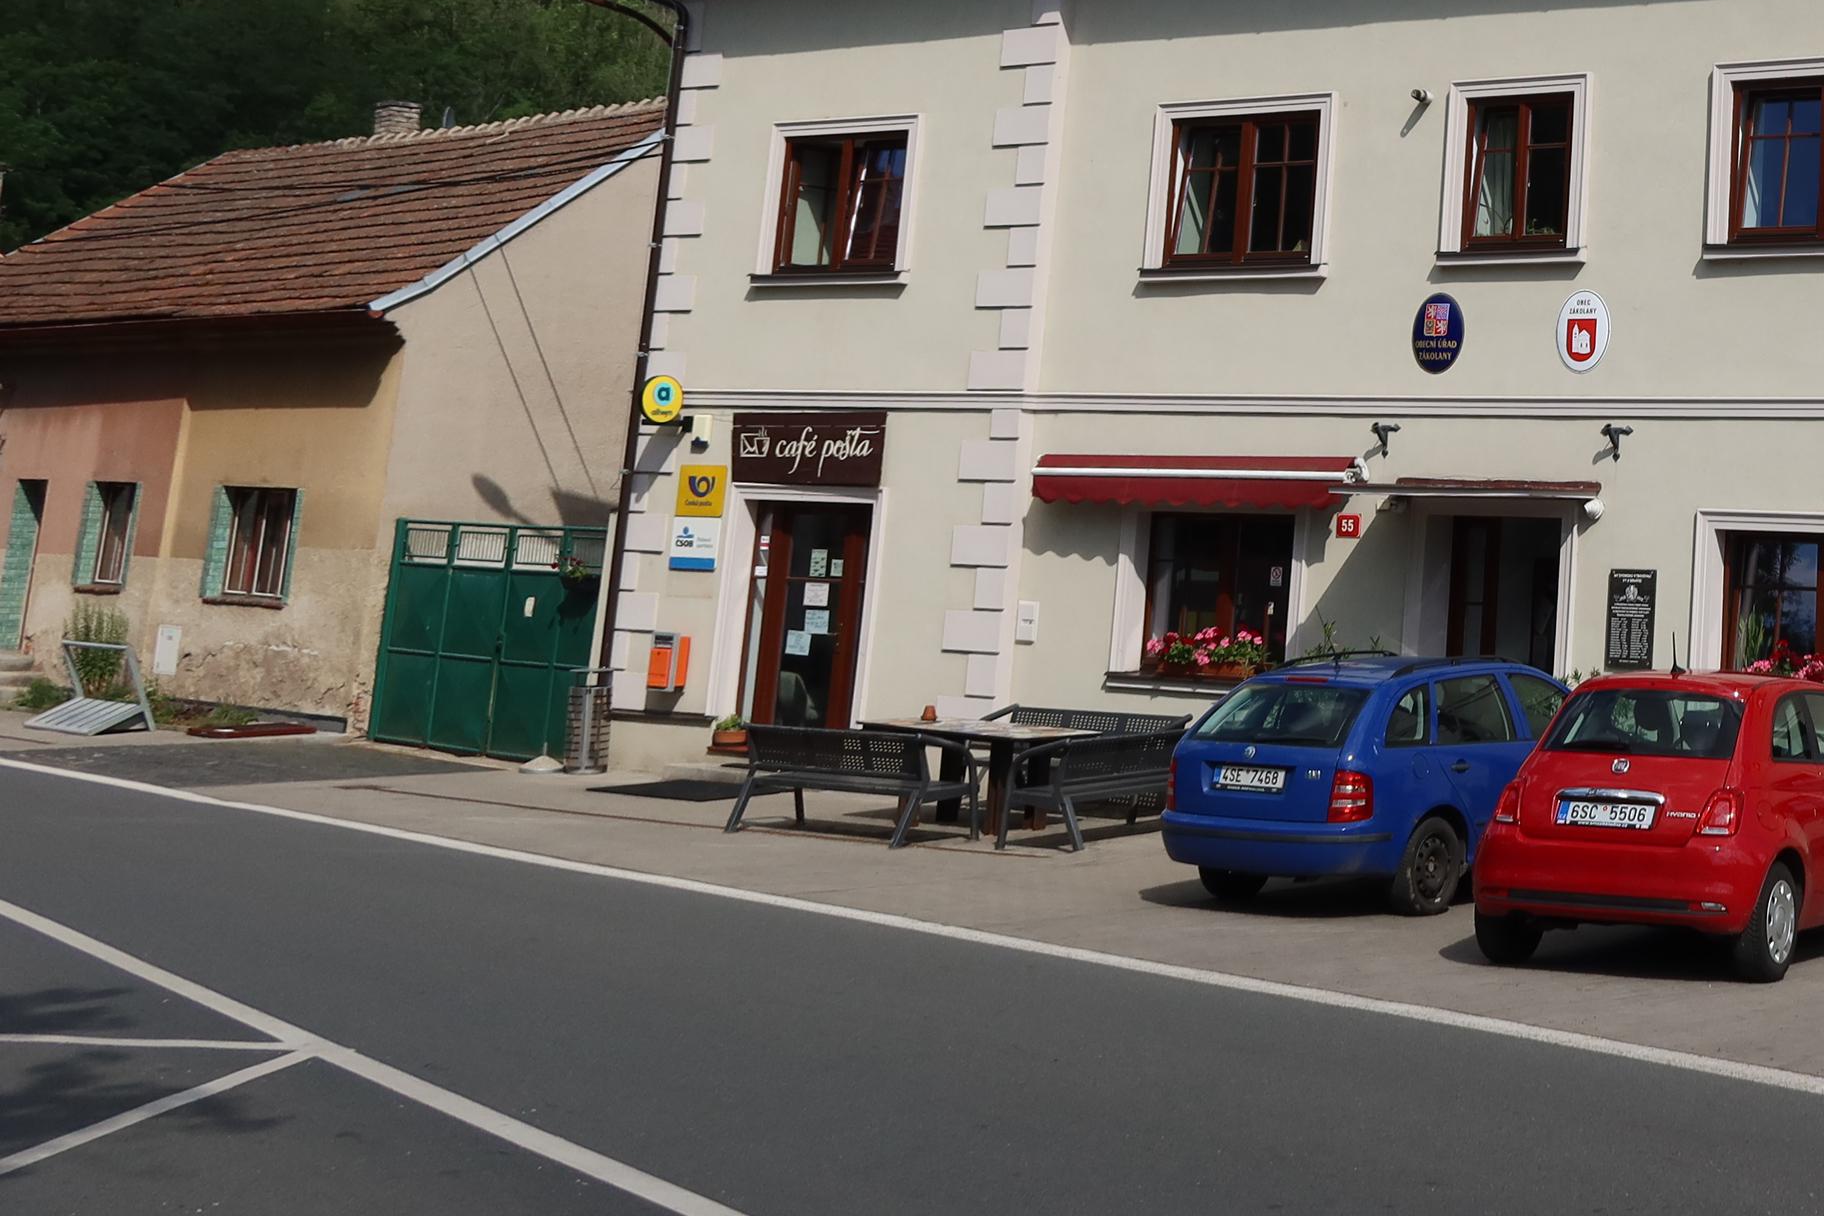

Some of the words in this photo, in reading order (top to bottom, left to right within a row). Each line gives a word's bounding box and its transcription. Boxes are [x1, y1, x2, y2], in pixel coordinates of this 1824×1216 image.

[1415, 338, 1437, 348] OBECNÍ
[1438, 338, 1457, 348] ÚŘAD
[1419, 350, 1452, 360] ZÁKOLANY
[775, 426, 818, 474] café
[817, 427, 880, 477] pošta
[1341, 519, 1354, 532] 55
[1222, 768, 1243, 782] 4SE
[1250, 769, 1279, 785] 7468
[1570, 804, 1598, 819] 6SC
[1609, 806, 1647, 822] 5506
